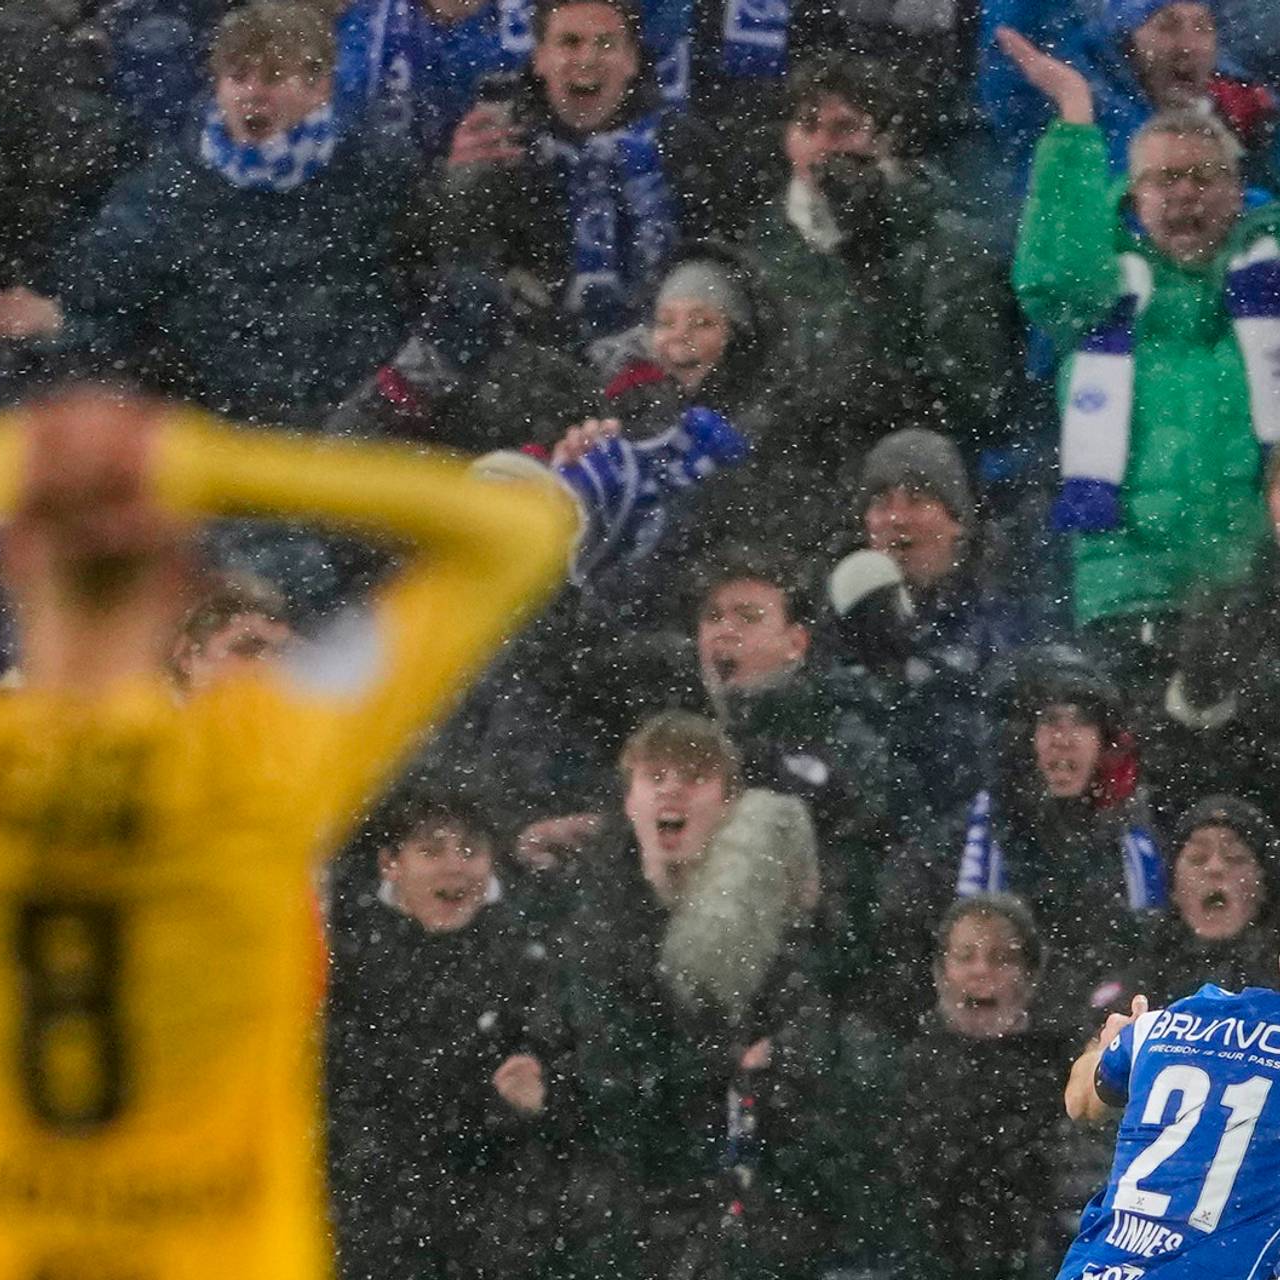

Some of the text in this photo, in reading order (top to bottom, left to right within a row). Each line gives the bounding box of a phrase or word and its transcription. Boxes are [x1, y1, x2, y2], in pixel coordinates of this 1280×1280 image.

[13, 890, 130, 1136] 8
[1105, 1210, 1184, 1258] LINNES
[1112, 1064, 1273, 1234] 21
